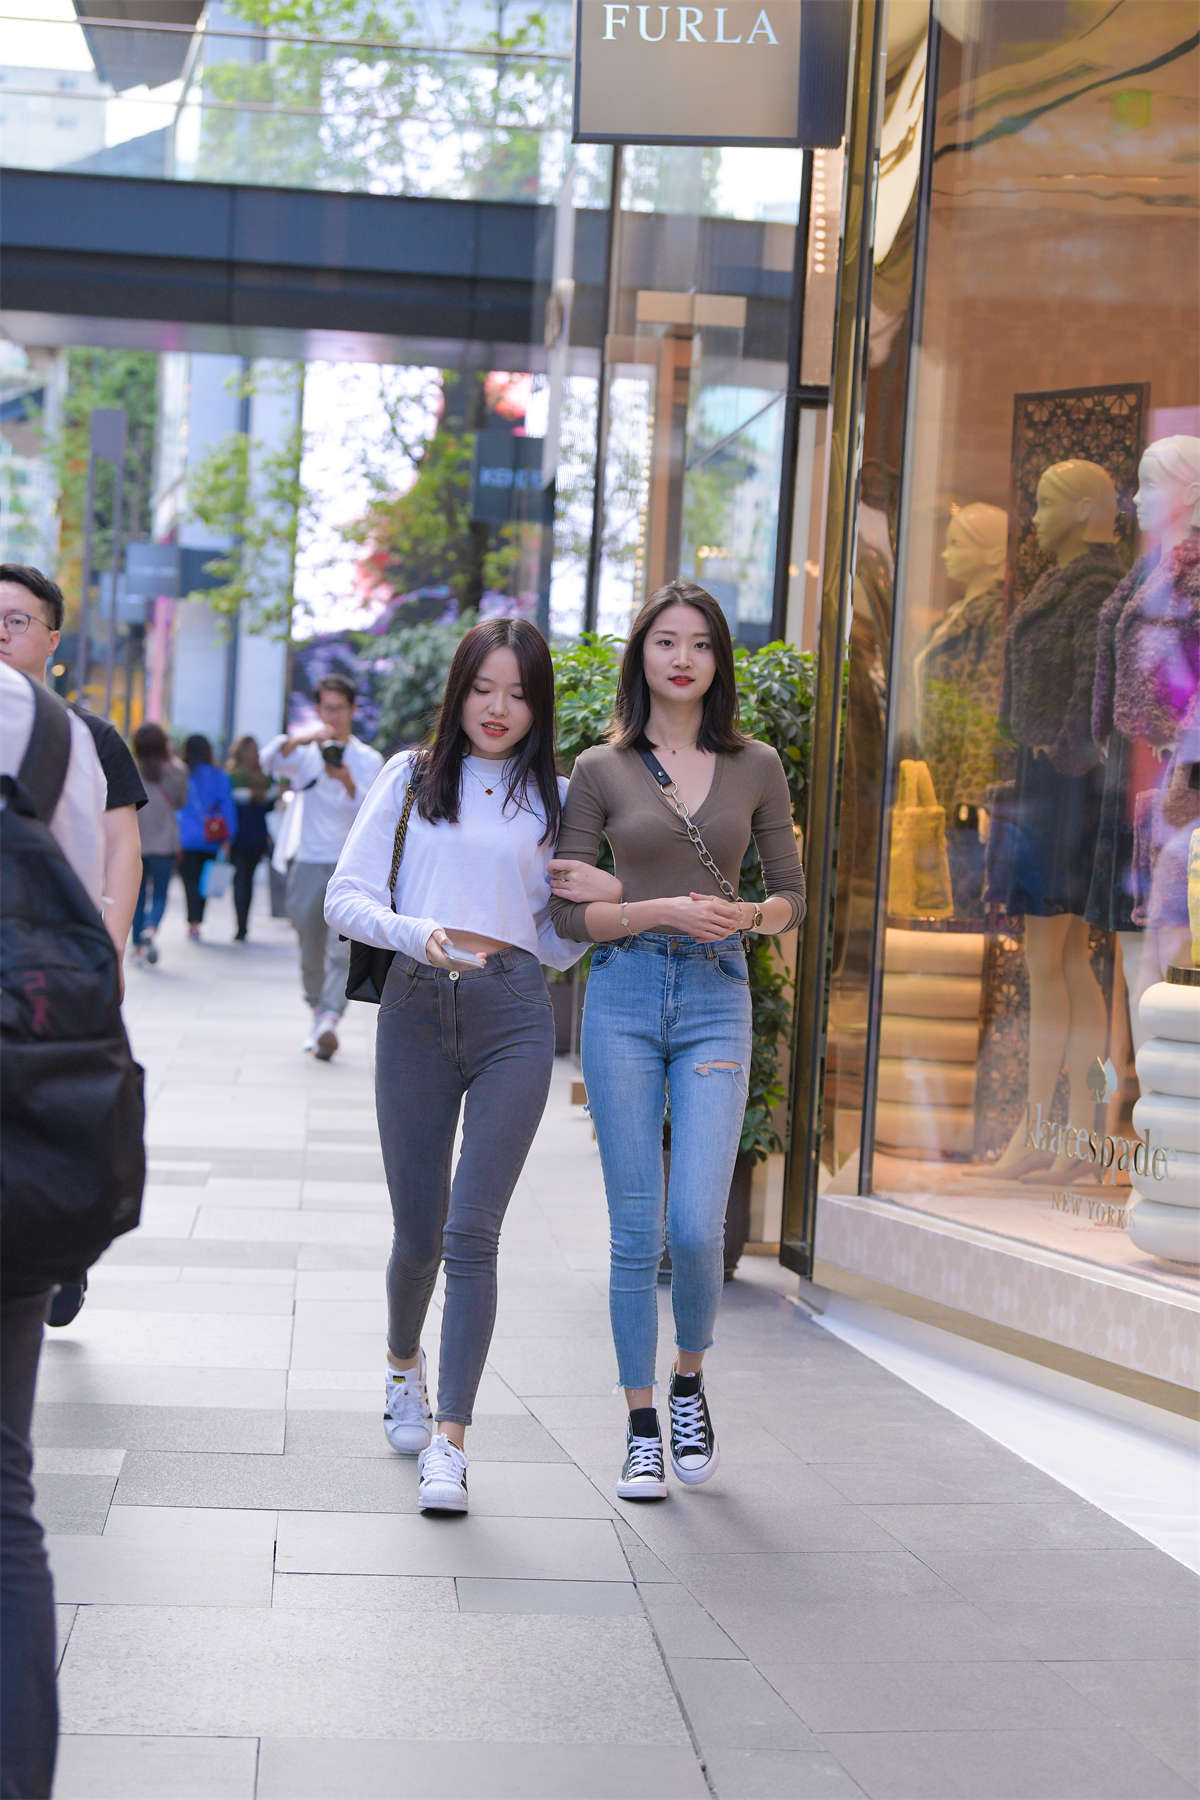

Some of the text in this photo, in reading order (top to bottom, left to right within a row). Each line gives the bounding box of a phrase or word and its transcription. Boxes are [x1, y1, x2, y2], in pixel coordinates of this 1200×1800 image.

[601, 4, 779, 45] FURLA
[1051, 1191, 1126, 1229] NEW YORK
